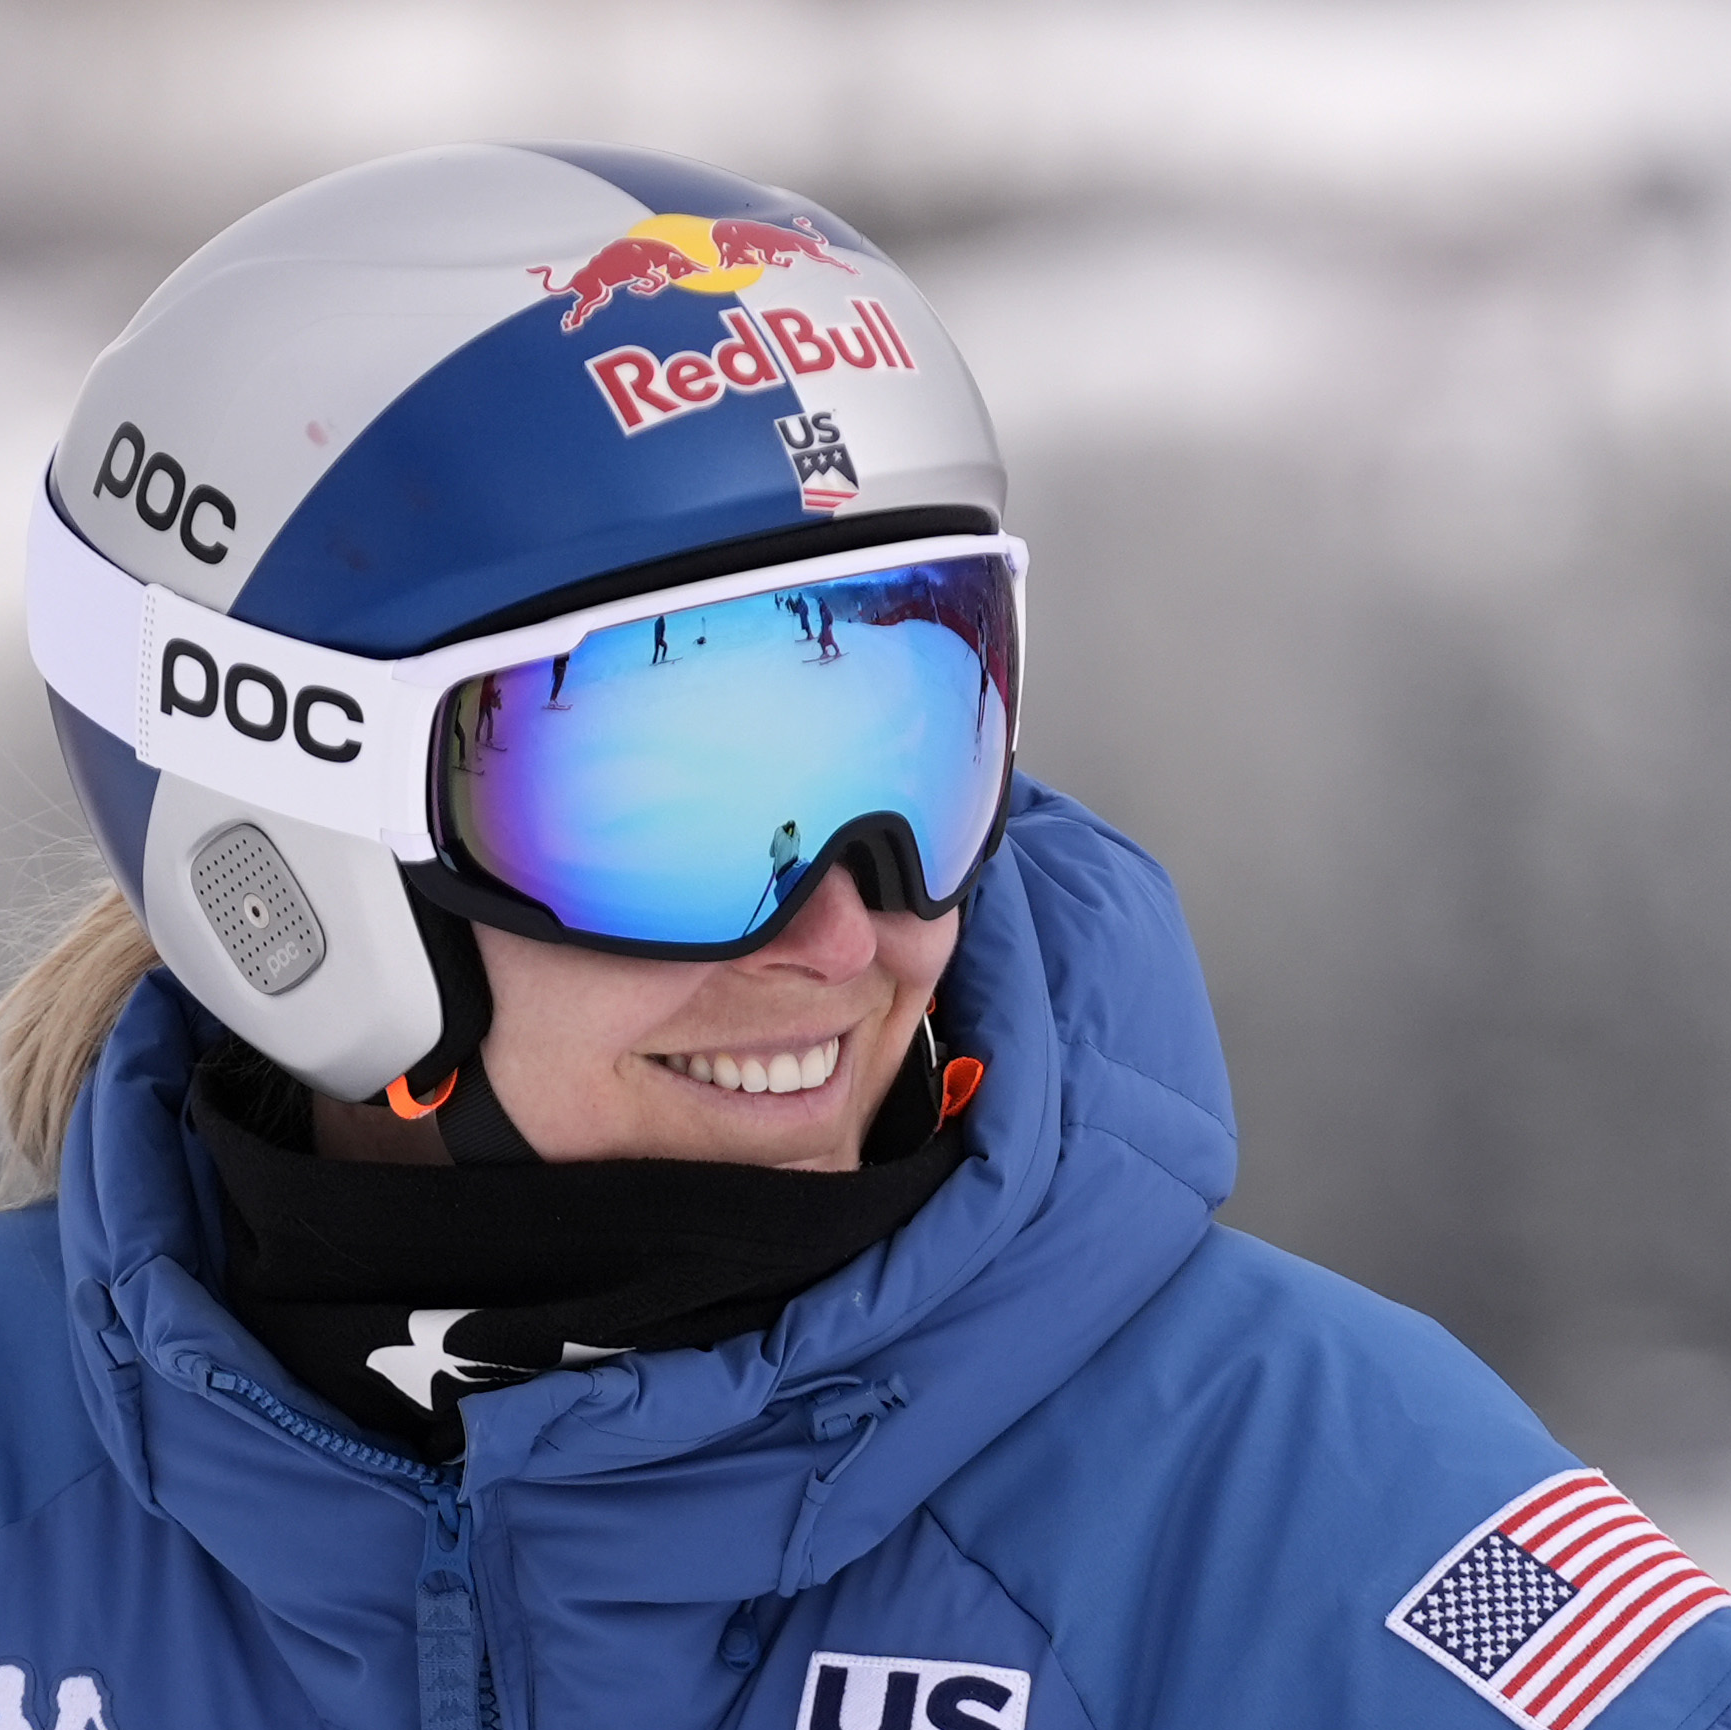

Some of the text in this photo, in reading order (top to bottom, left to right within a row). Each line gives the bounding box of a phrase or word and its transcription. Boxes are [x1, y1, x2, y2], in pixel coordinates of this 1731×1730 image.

[593, 300, 915, 428] Red Bull
[777, 411, 840, 449] US
